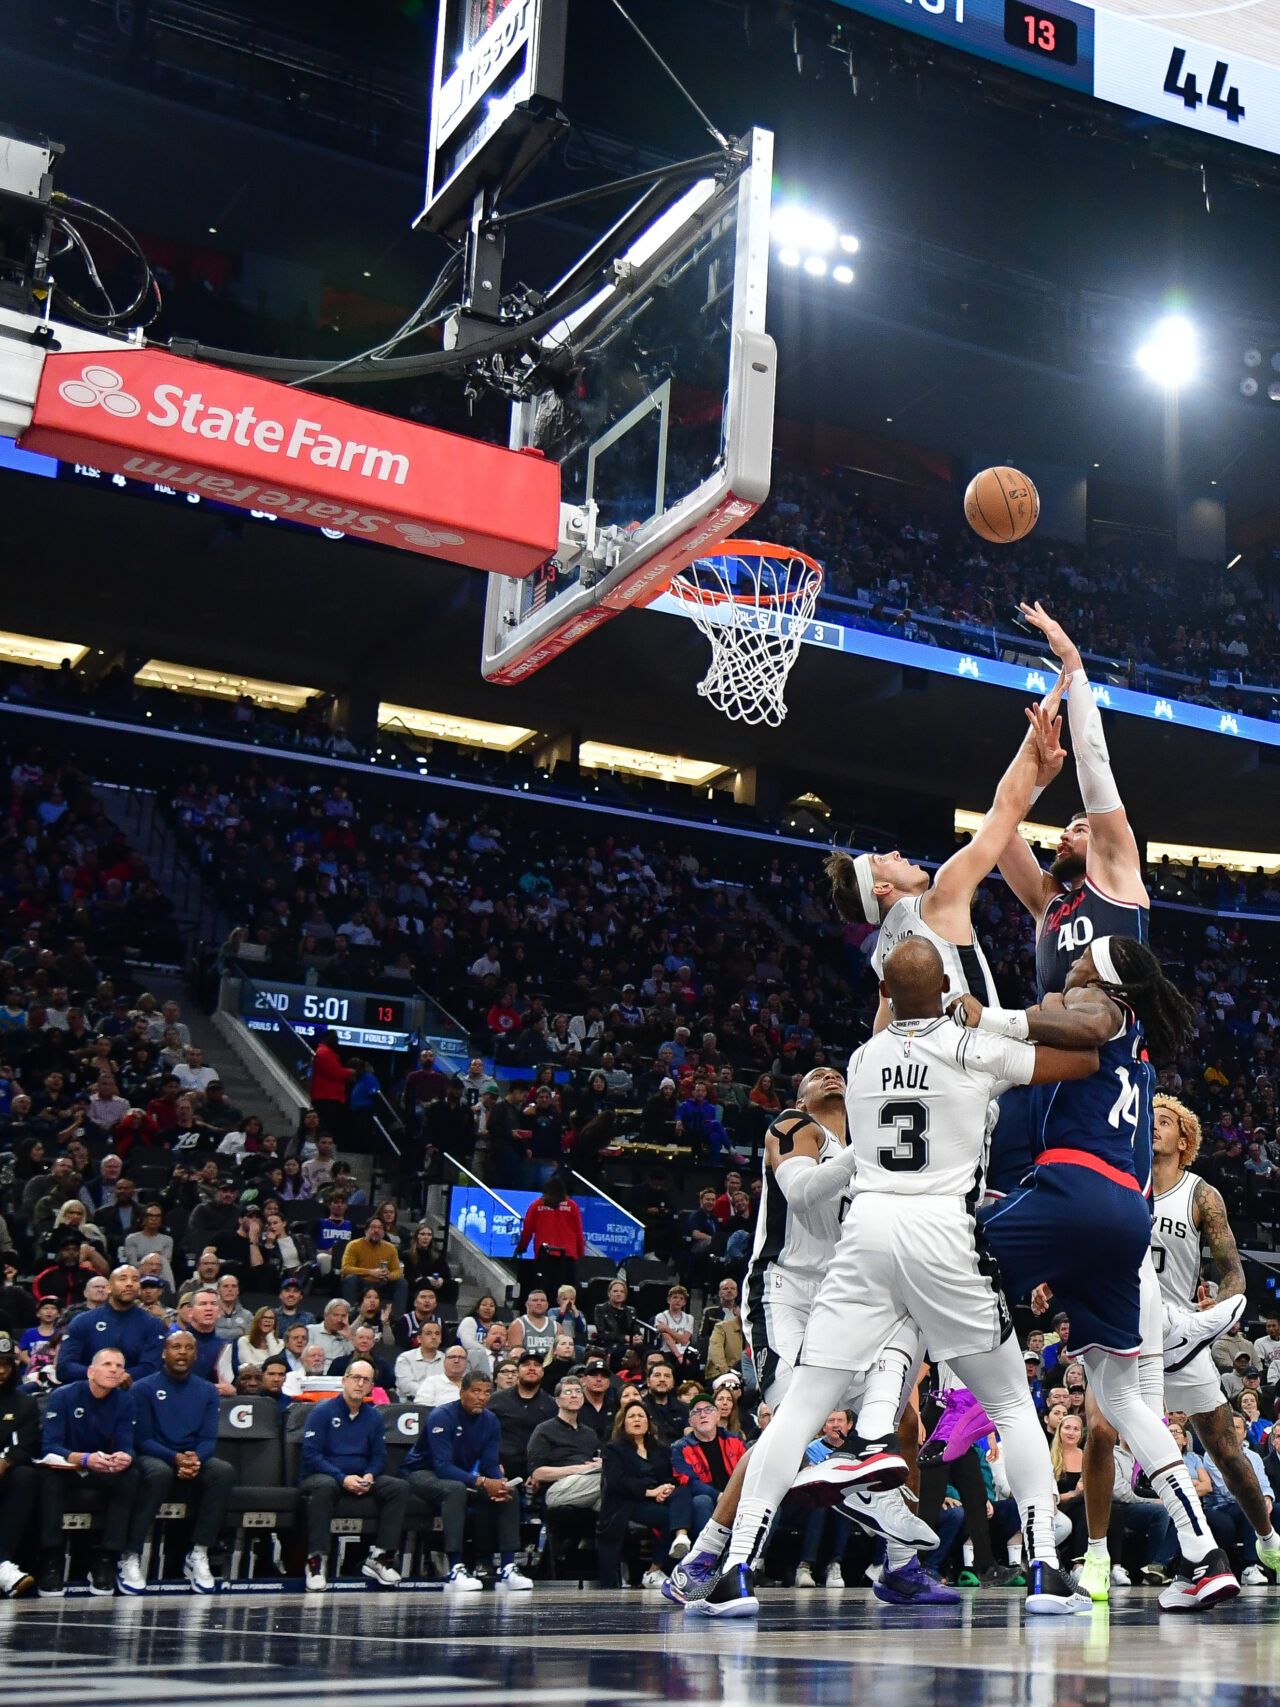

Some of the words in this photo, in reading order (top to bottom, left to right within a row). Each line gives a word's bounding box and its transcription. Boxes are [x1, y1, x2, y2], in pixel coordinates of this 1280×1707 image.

[1024, 15, 1056, 51] 13
[1163, 46, 1246, 124] 44
[814, 626, 824, 641] 3
[1057, 916, 1093, 952] 40
[254, 991, 289, 1011] 2ND
[303, 994, 349, 1022] 5:01
[377, 1007, 393, 1023] 13
[882, 1064, 929, 1091] PAUL
[877, 1098, 930, 1173] 3
[323, 1228, 352, 1240] CLIPPERS
[229, 1404, 253, 1429] G
[397, 1413, 419, 1435] G
